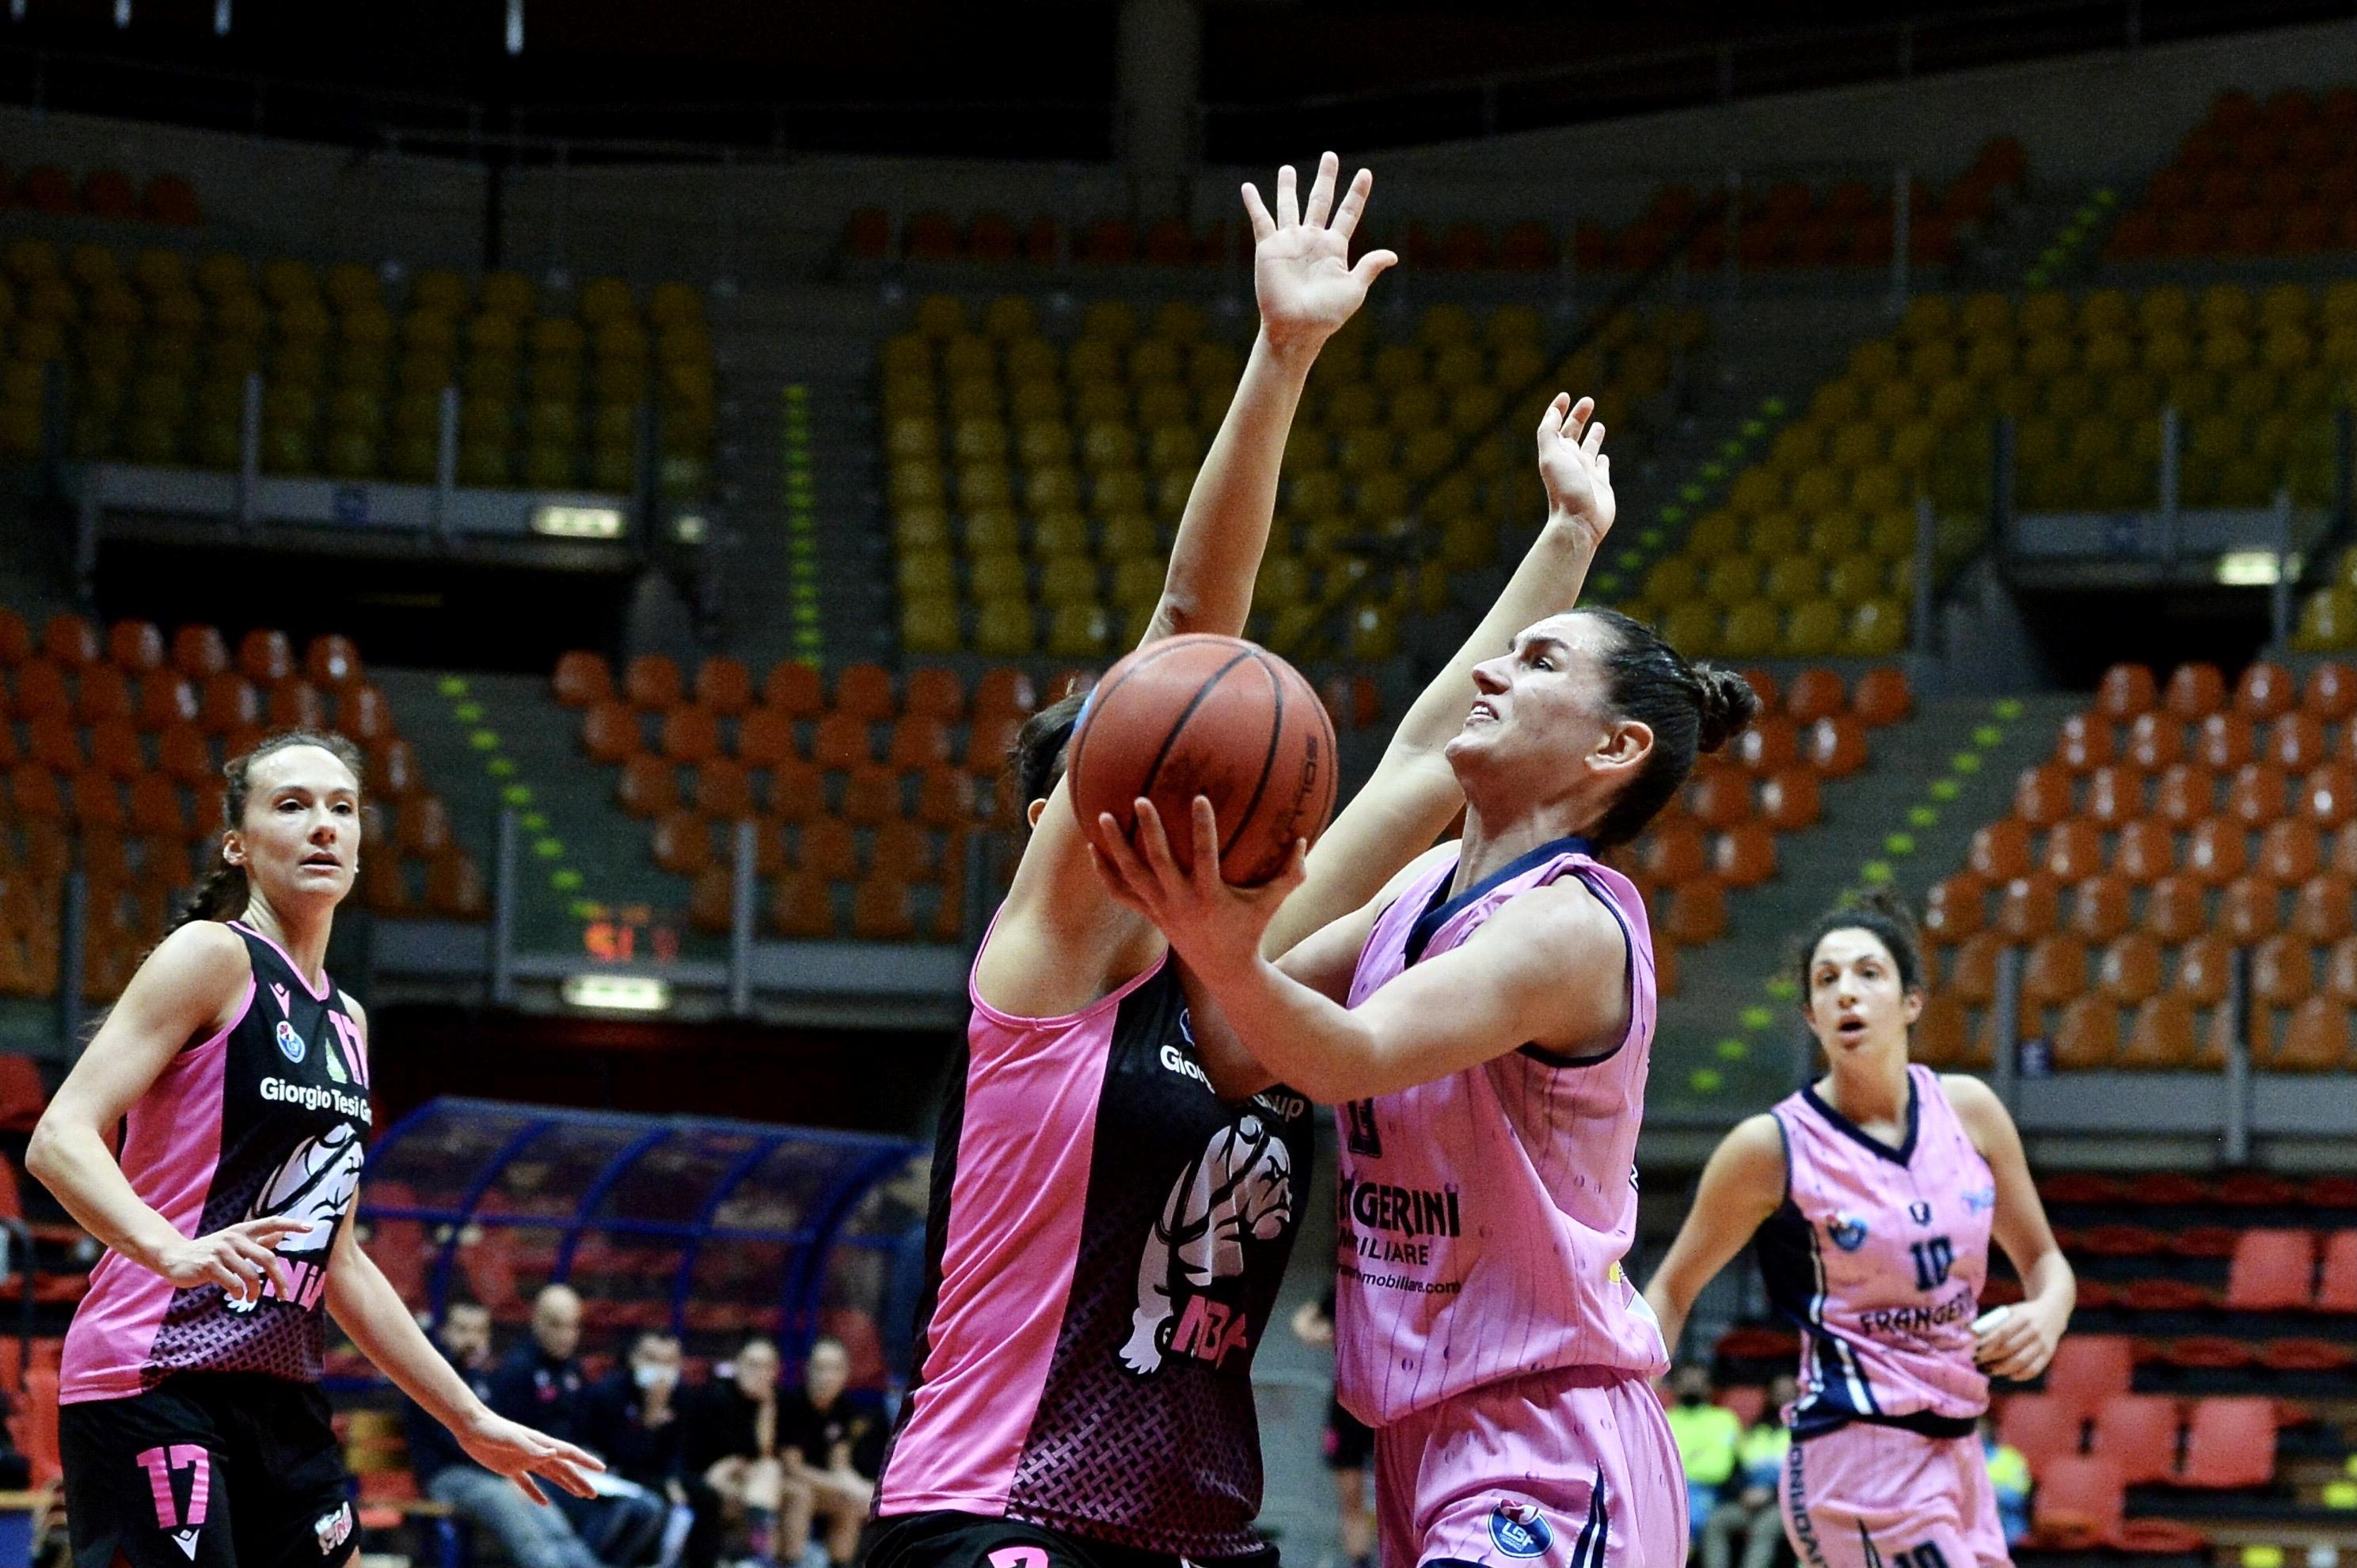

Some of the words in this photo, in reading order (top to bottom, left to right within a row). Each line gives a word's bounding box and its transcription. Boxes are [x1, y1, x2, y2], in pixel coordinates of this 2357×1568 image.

[260, 1076, 331, 1111] Giorgio
[331, 1088, 359, 1118] Tesi
[360, 1098, 372, 1127] G
[1340, 1176, 1461, 1238] NGERINI
[1910, 1236, 1954, 1292] 10
[136, 1444, 209, 1529] 17
